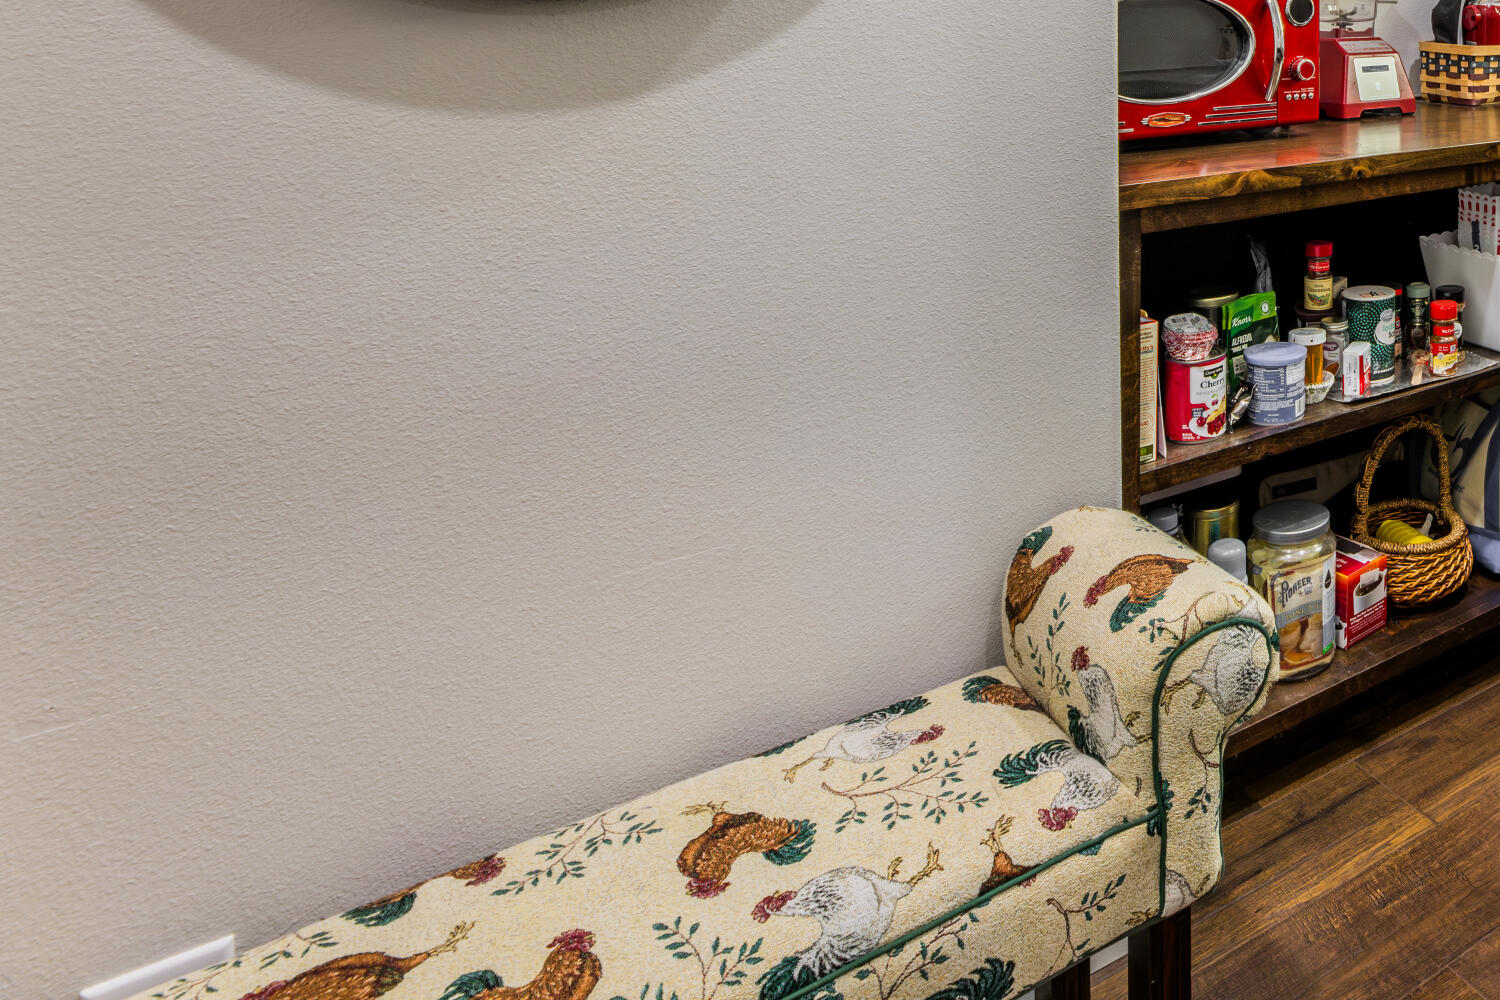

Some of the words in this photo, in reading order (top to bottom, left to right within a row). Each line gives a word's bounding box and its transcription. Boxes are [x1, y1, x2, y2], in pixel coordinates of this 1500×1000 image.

[1232, 315, 1251, 328] Knorr
[1200, 377, 1225, 389] Cherry
[1278, 576, 1312, 608] PIONEER
